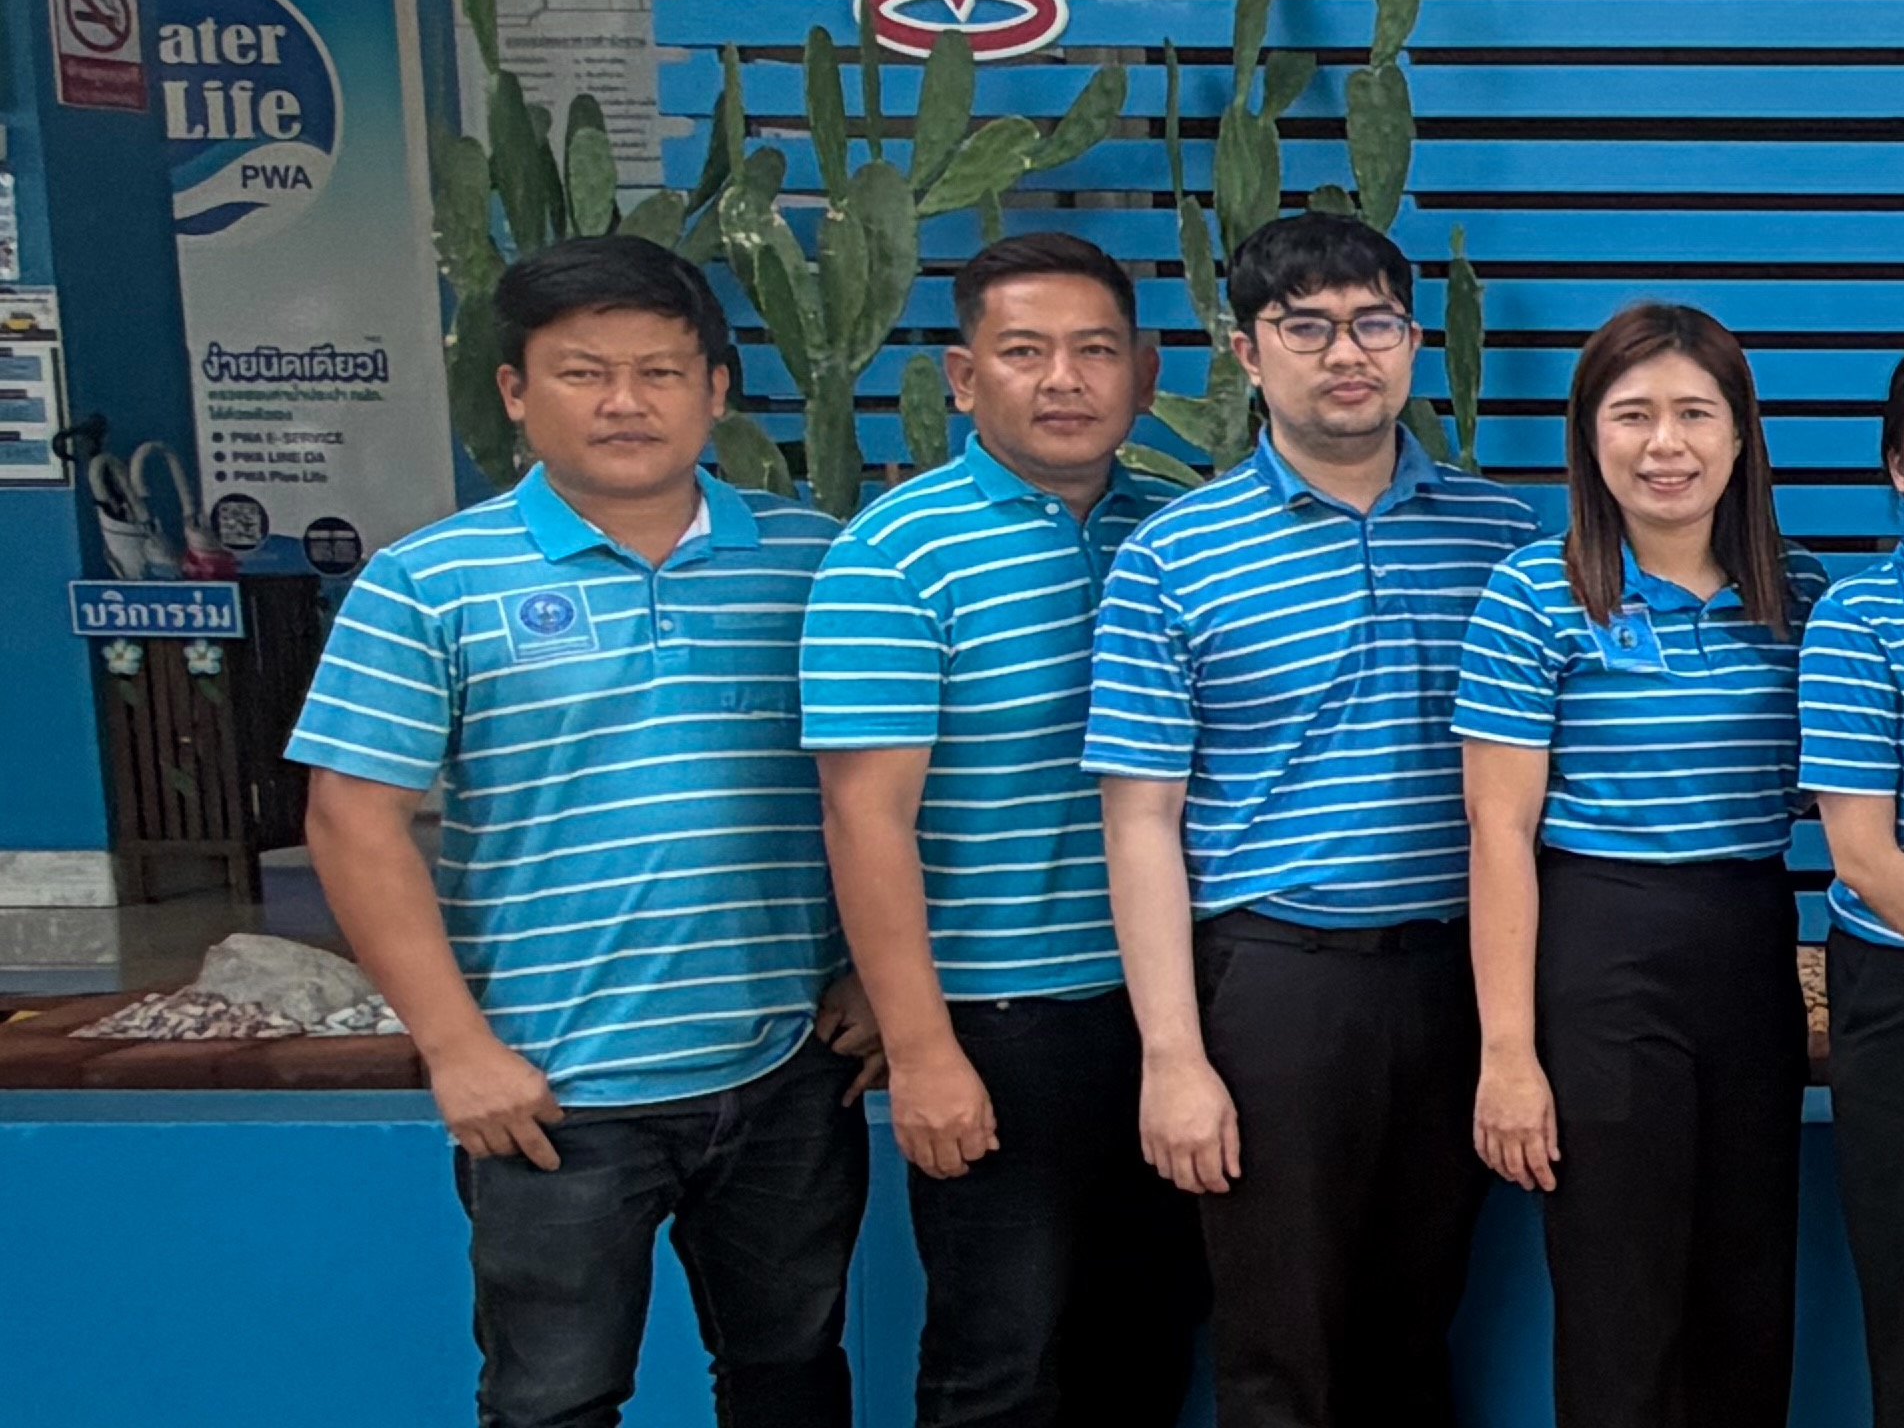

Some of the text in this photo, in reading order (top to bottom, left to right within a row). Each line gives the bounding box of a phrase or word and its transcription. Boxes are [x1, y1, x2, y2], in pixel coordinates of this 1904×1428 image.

[158, 16, 287, 65] ater
[162, 79, 302, 140] Life
[241, 164, 313, 190] PWA
[81, 590, 232, 629] บริการร่ม
